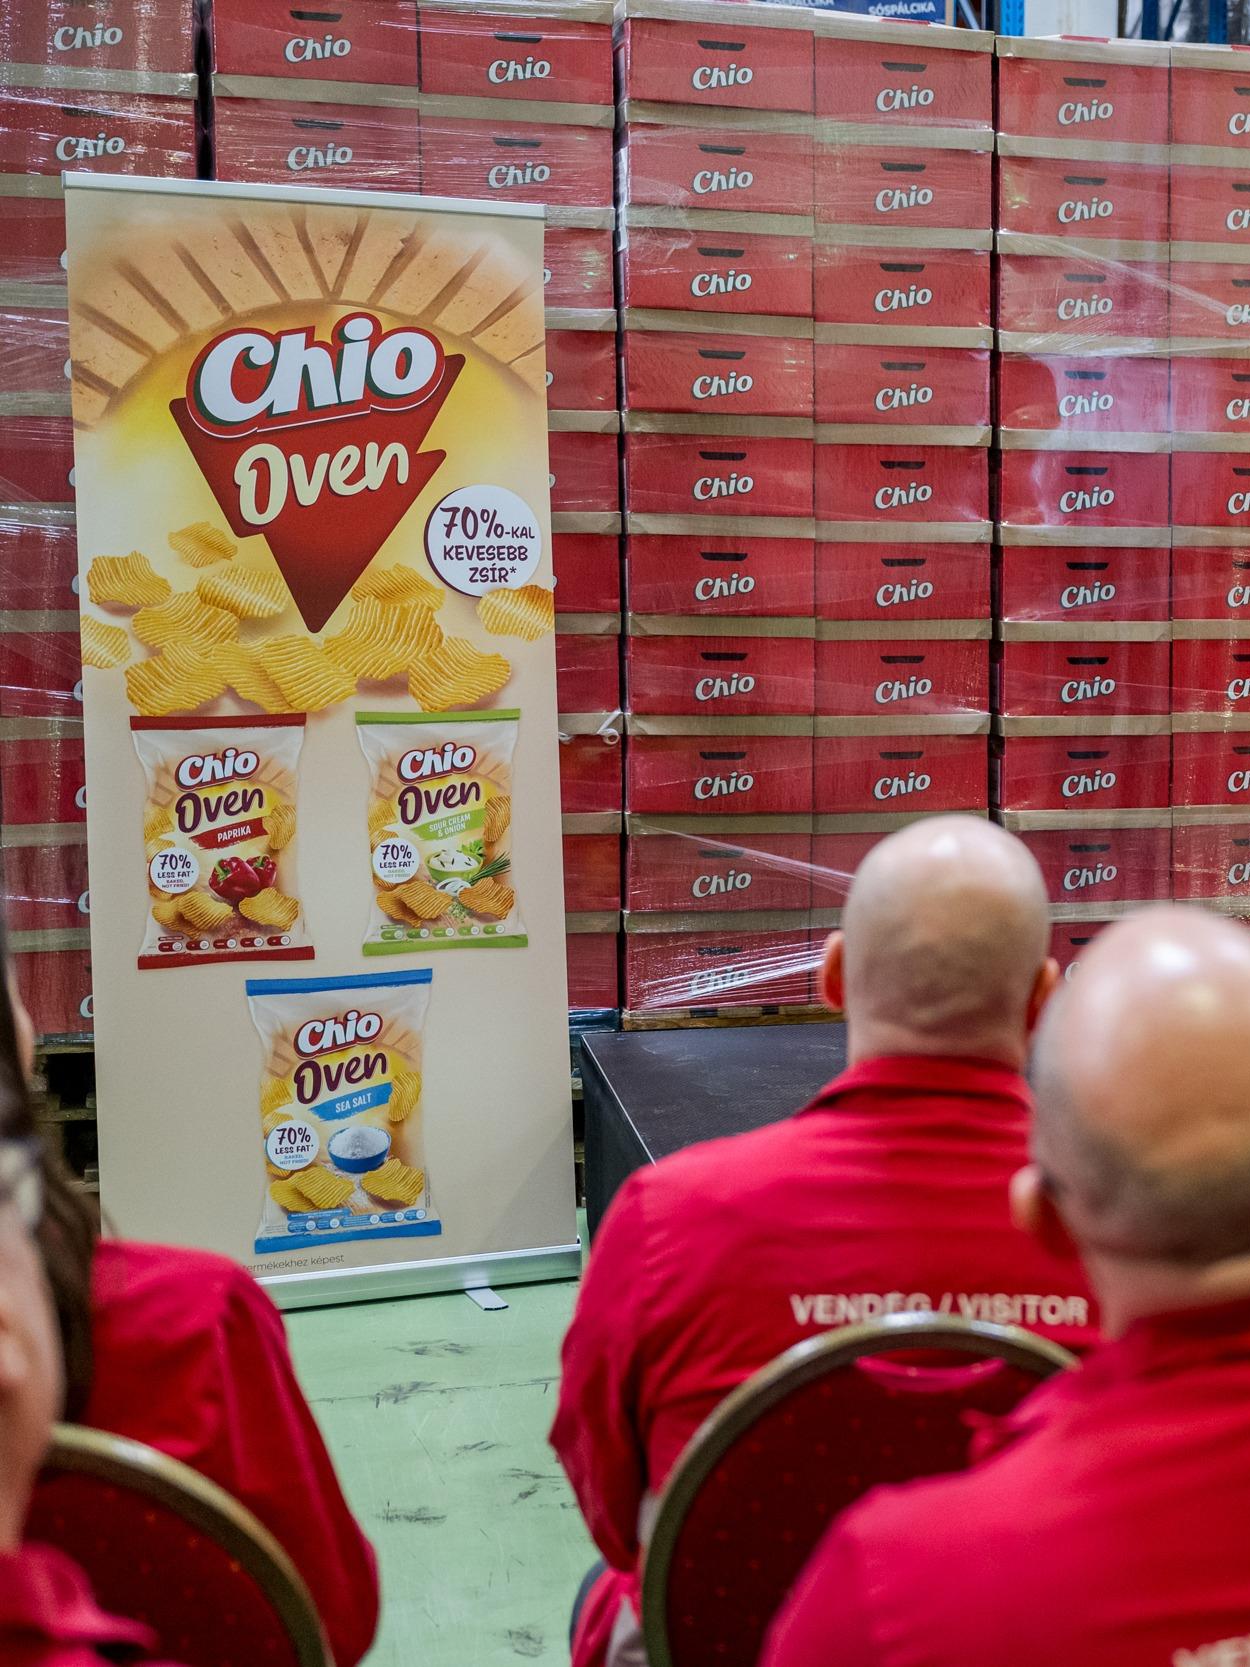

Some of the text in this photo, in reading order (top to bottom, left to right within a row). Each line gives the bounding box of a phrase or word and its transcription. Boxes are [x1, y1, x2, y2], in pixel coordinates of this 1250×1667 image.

[54, 23, 123, 51] Chio
[285, 35, 352, 63] Chio
[488, 56, 552, 84] Chio
[692, 64, 753, 90] Chio
[876, 86, 935, 112] Chio
[1058, 100, 1114, 125] Chio
[56, 133, 126, 161] Chio
[287, 143, 353, 171] Chio
[488, 161, 551, 189] Chio
[693, 168, 754, 194] Chio
[875, 186, 933, 212] Chio
[1058, 198, 1114, 223] Chio
[691, 271, 752, 297] Chio
[874, 286, 933, 312] Chio
[1057, 295, 1113, 321] Chio
[197, 317, 437, 424] Chio
[692, 373, 753, 399] Chio
[875, 384, 933, 411] Chio
[1059, 391, 1114, 417] Chio
[234, 441, 410, 526] Oven
[693, 474, 754, 500] Chio
[875, 483, 933, 509] Chio
[1059, 487, 1115, 513] Chio
[440, 506, 535, 540] 70%-KAL
[443, 545, 528, 561] KEVESEBB
[695, 574, 755, 601] Chio
[876, 579, 934, 607] Chio
[1060, 582, 1116, 609] Chio
[695, 674, 755, 701] Chio
[875, 676, 932, 704] Chio
[1061, 676, 1116, 703] Chio
[178, 748, 258, 787] Chio
[400, 743, 474, 780] Chio
[694, 772, 754, 800] Chio
[874, 772, 931, 800] Chio
[1062, 770, 1117, 797] Chio
[175, 788, 264, 833] Oven
[398, 782, 480, 825] Oven
[217, 826, 251, 842] PAPRIKA
[429, 813, 471, 833] SOUR CREAM
[445, 823, 466, 836] ONION
[158, 854, 192, 871] 70%
[379, 861, 398, 869] LESS
[380, 844, 412, 860] 70%
[692, 870, 752, 898] Chio
[1063, 863, 1118, 891] Chio
[298, 1010, 381, 1054] Chio
[294, 1052, 387, 1104] Oven
[335, 1093, 372, 1113] SEA SALT
[276, 1127, 311, 1145] 70%
[275, 1147, 294, 1155] LESS
[311, 1255, 345, 1266] képest
[957, 1292, 1088, 1326] VISITOR
